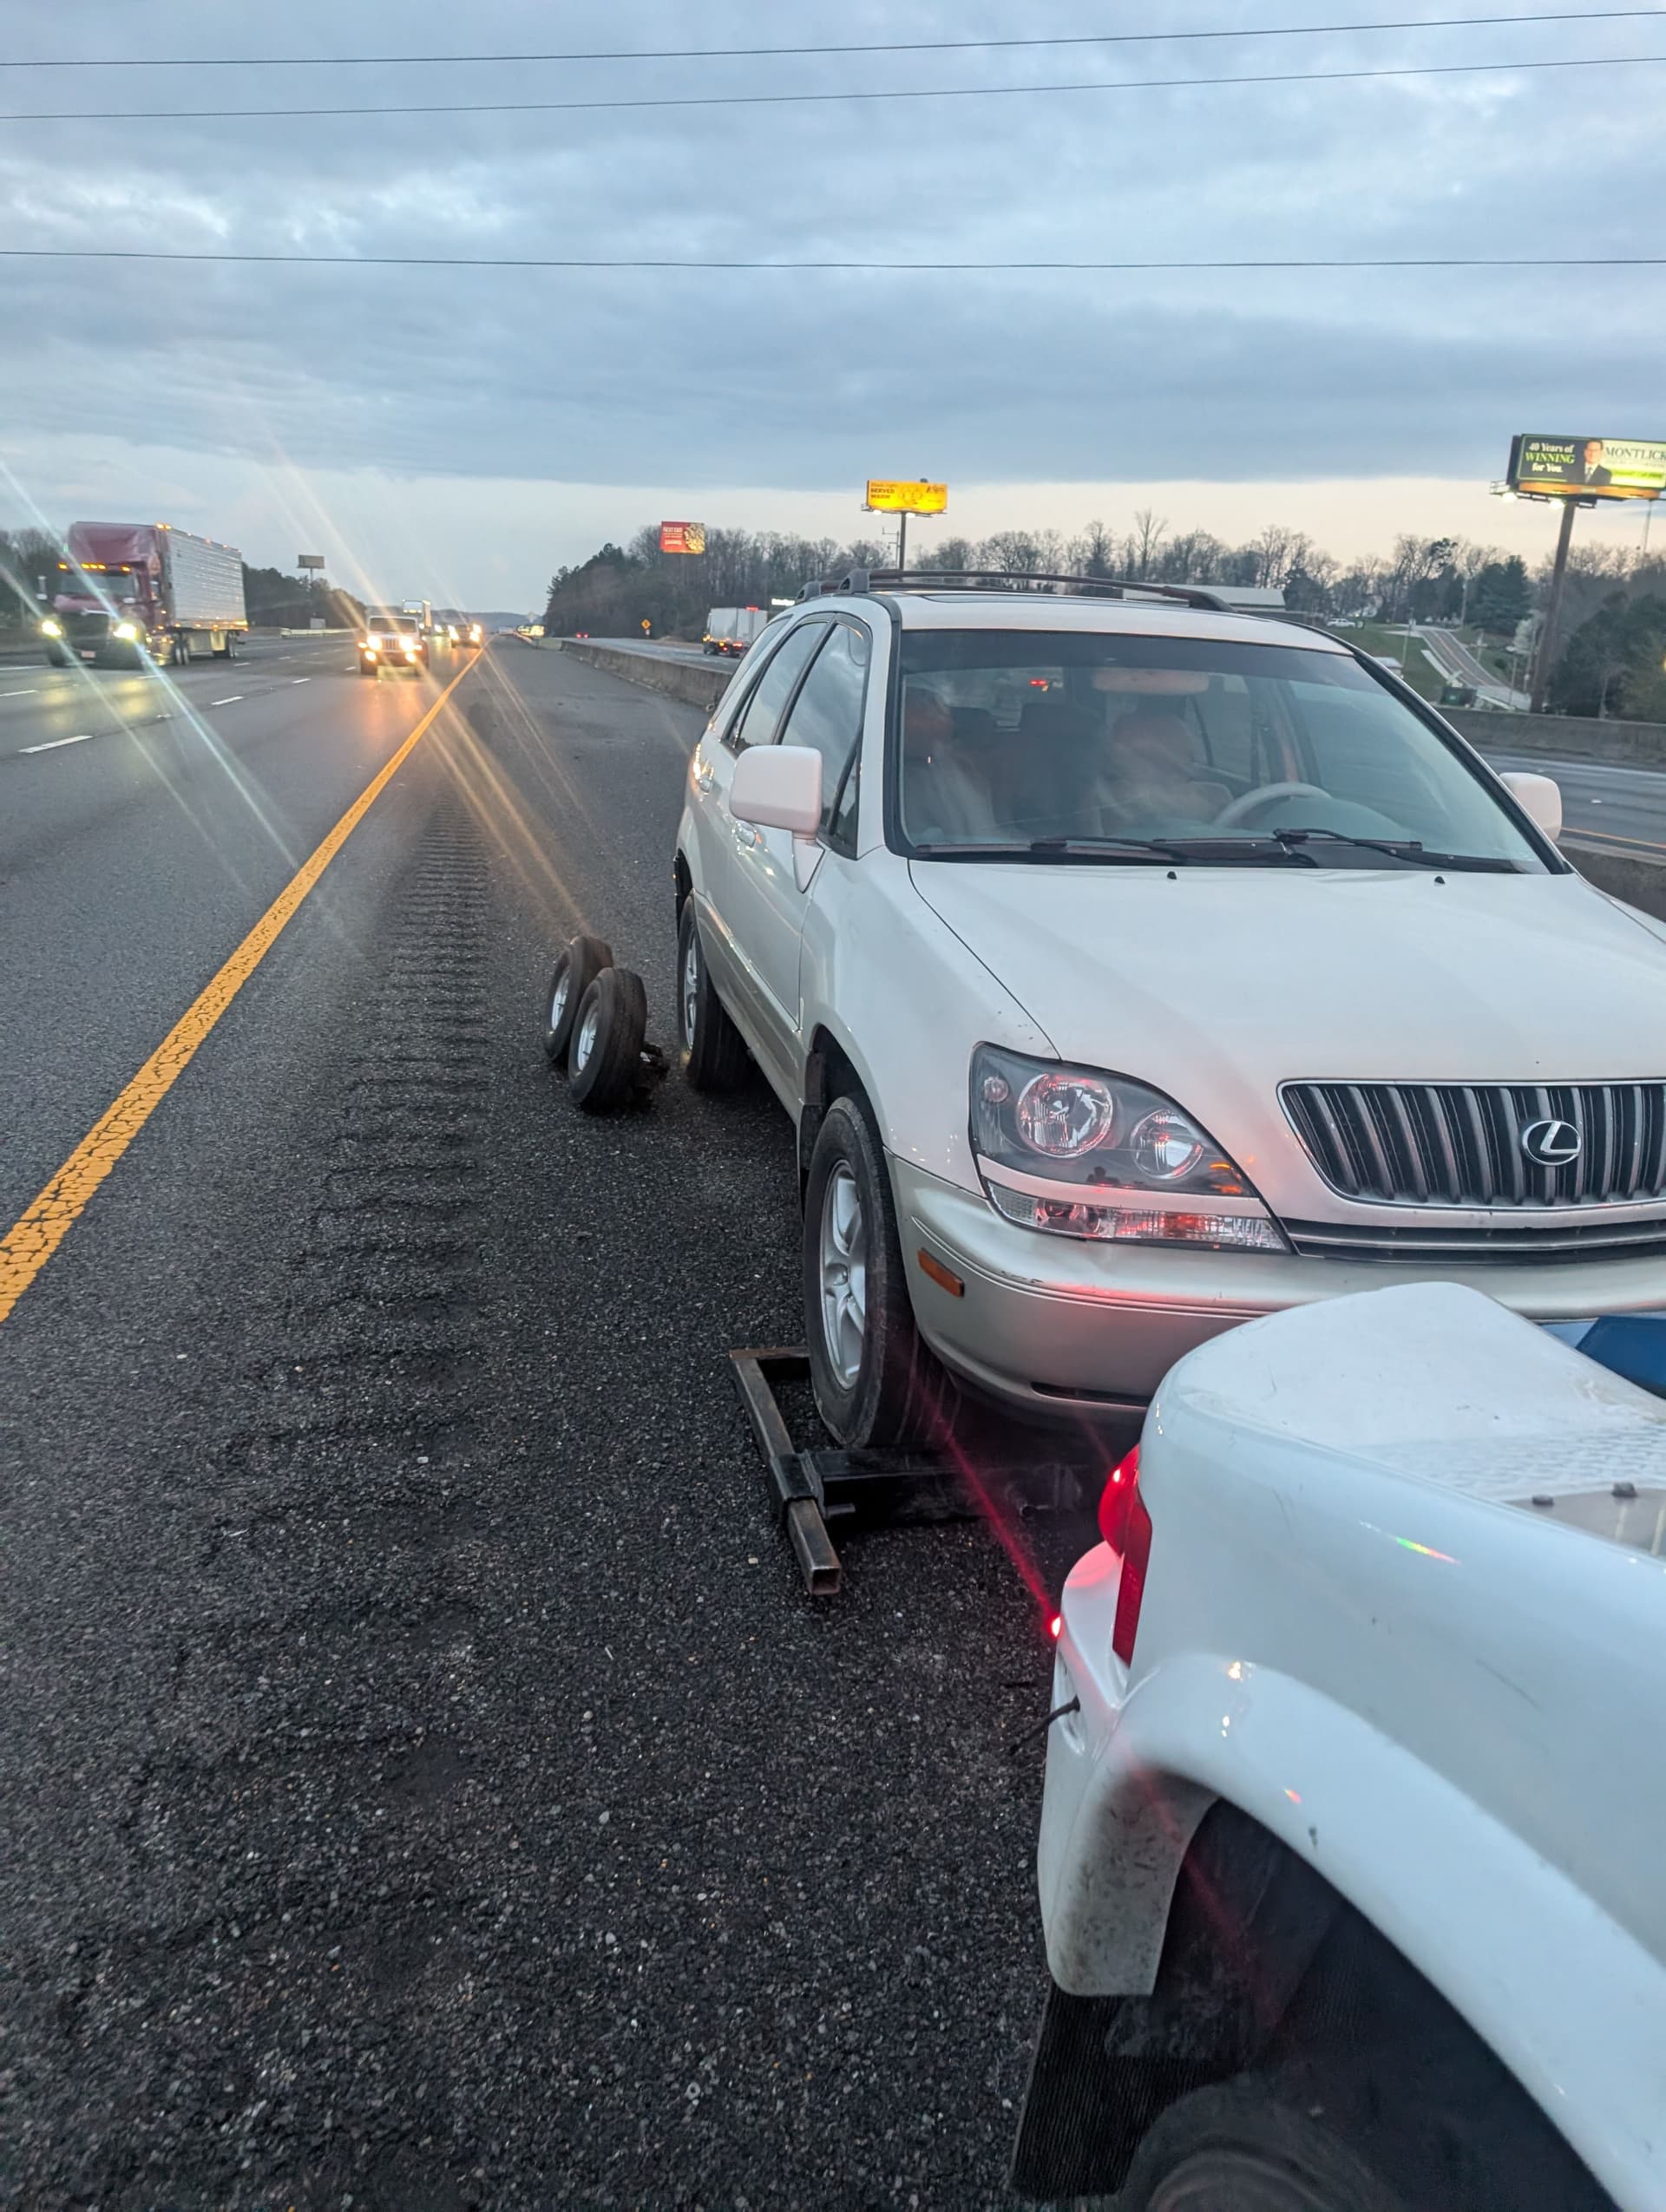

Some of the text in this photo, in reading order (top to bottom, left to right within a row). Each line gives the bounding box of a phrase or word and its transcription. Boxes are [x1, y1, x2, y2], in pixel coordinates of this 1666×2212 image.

[1529, 442, 1575, 453] 40 Years of
[1525, 452, 1576, 464] WINNING
[1532, 462, 1545, 471] for
